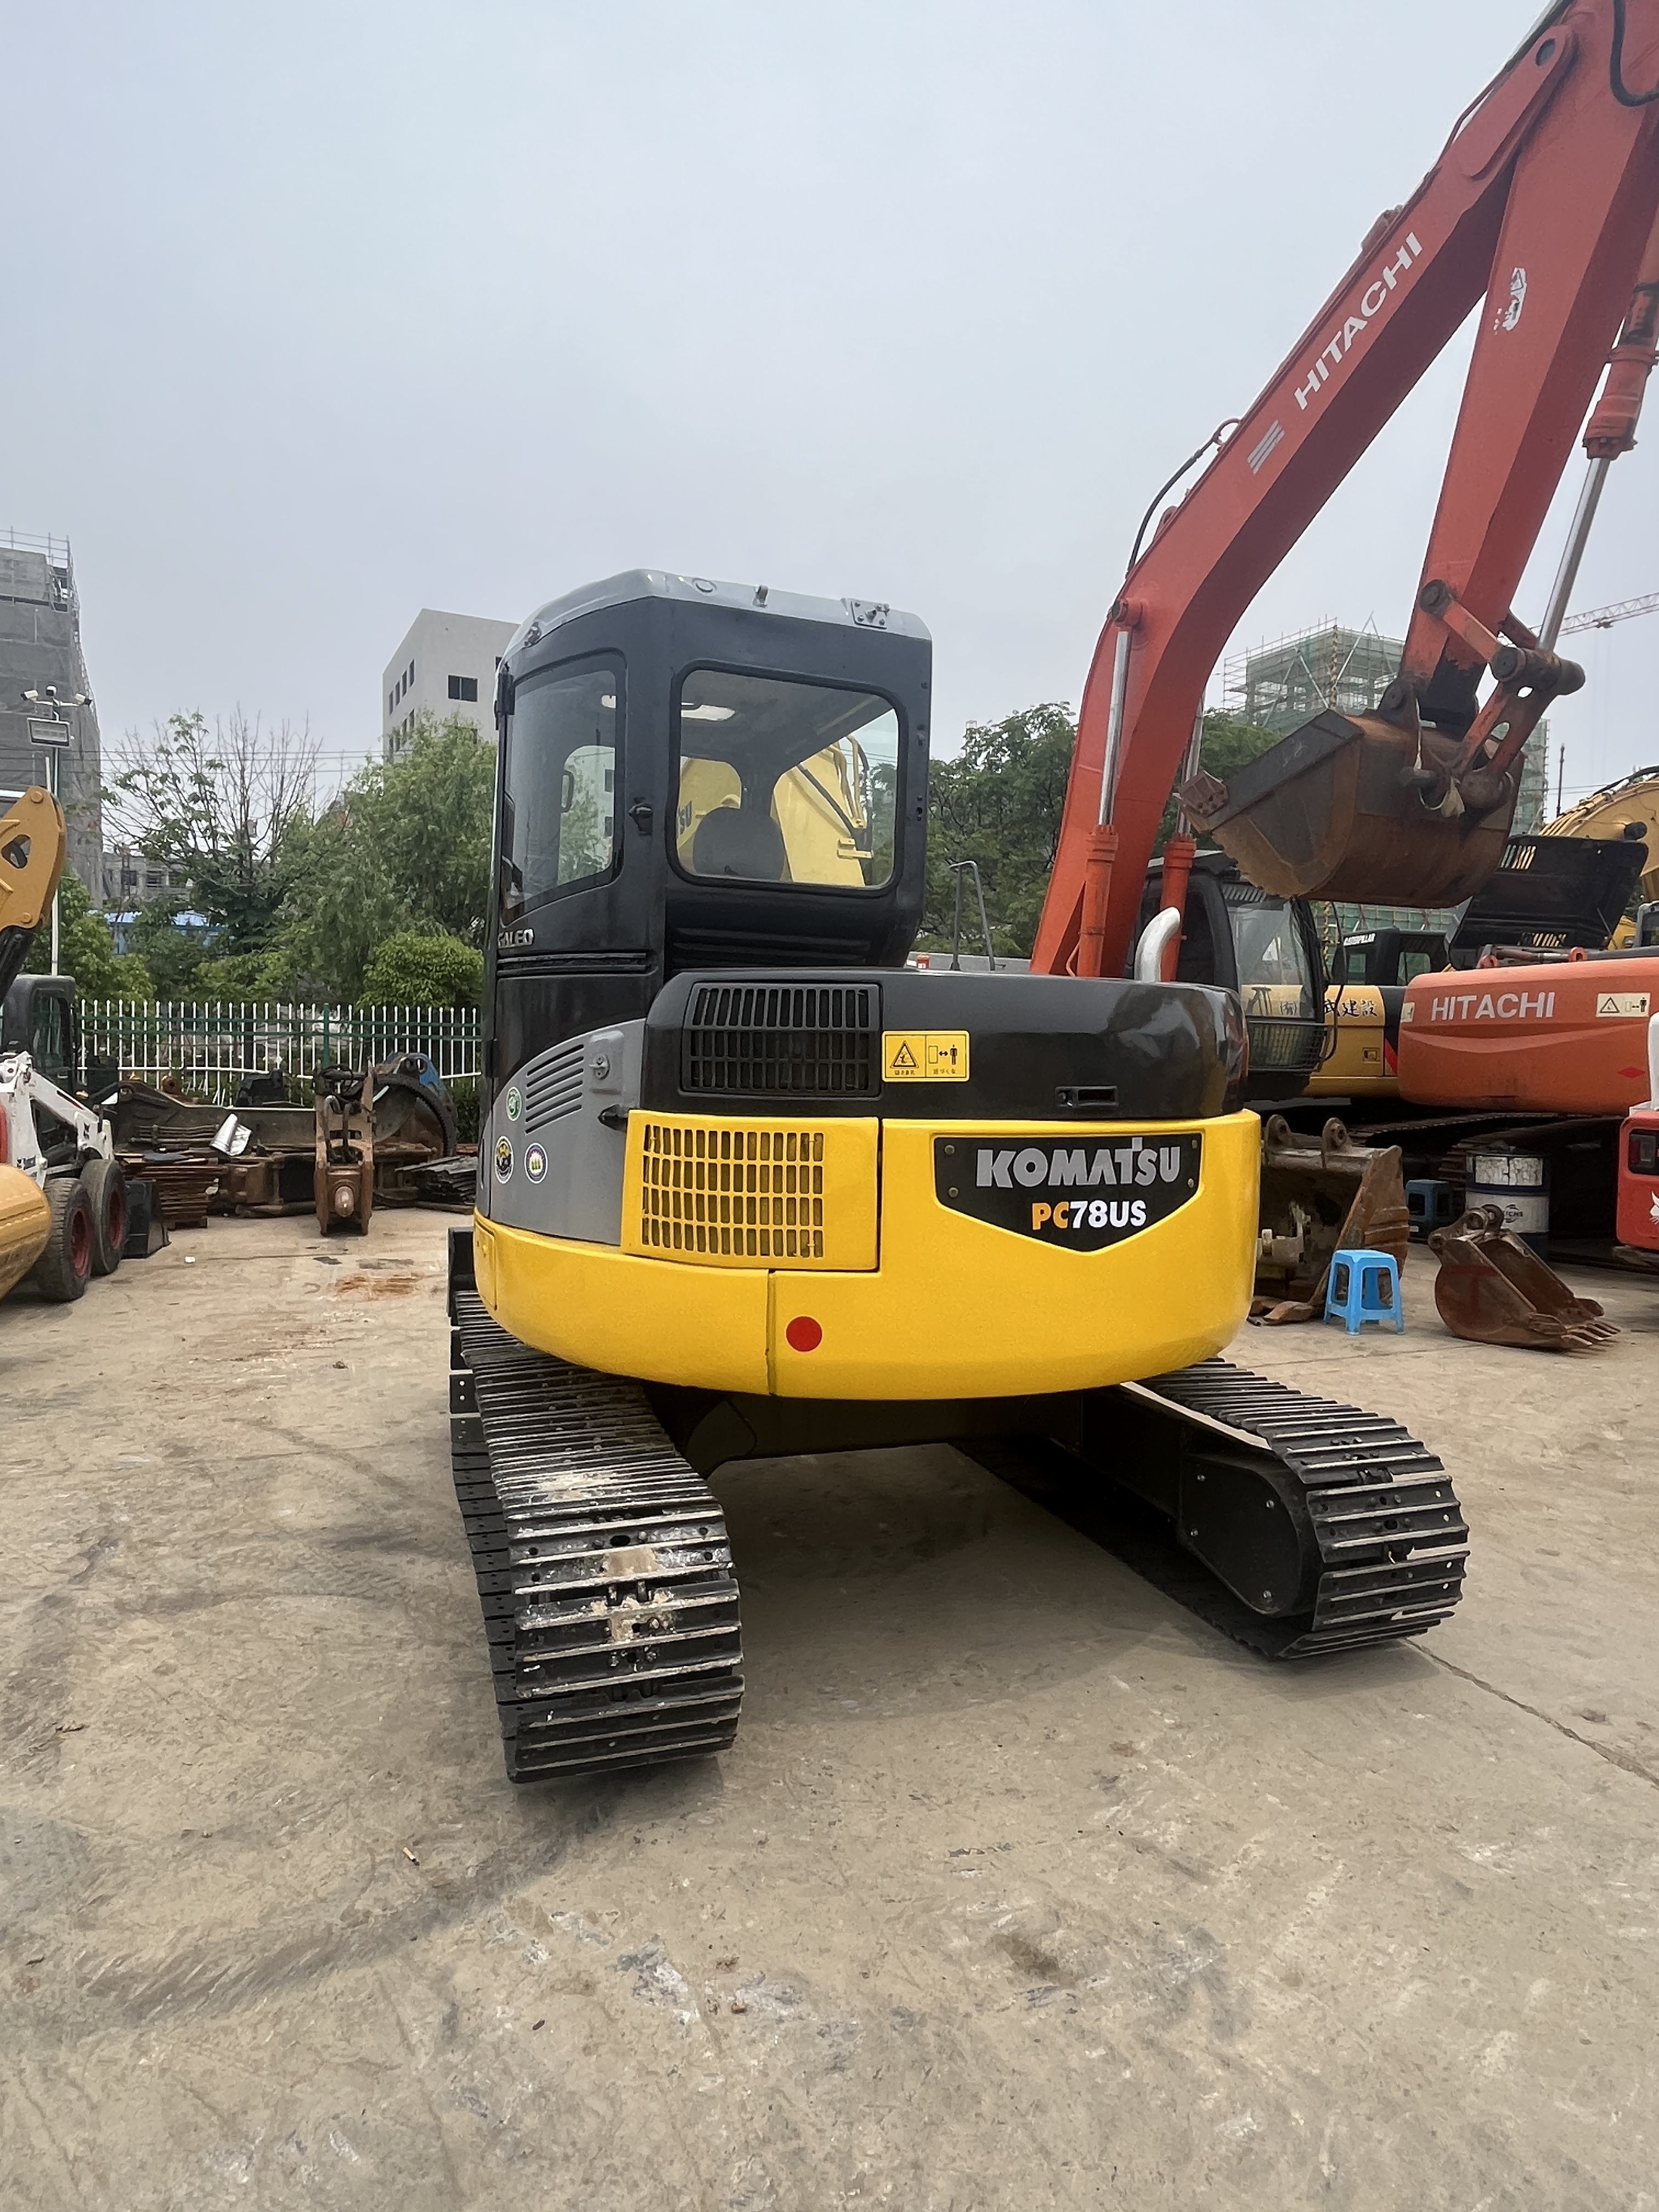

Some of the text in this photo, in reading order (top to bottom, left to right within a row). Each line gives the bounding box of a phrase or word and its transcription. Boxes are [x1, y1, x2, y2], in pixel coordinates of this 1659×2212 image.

[1294, 232, 1423, 411] HITACHI
[1431, 991, 1555, 1022] HITACHI
[975, 1137, 1181, 1188] KOMATSU
[1031, 1199, 1147, 1230] PC78US
